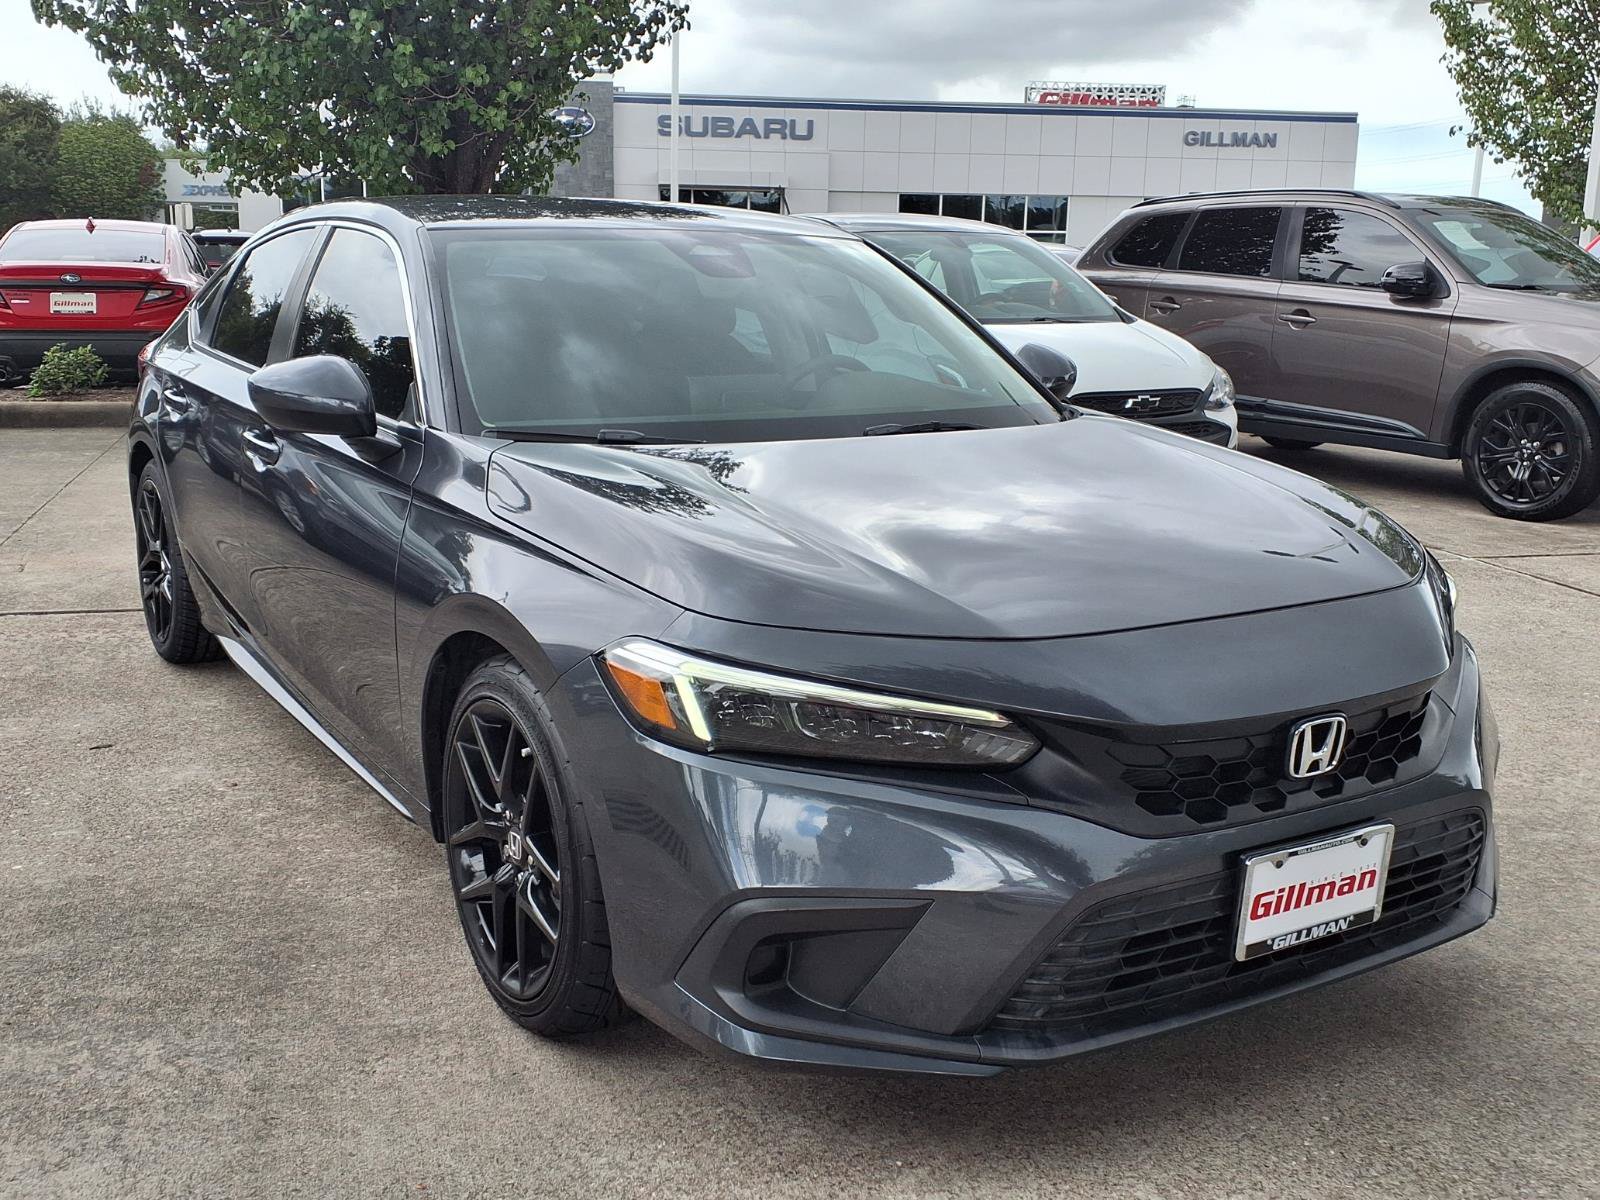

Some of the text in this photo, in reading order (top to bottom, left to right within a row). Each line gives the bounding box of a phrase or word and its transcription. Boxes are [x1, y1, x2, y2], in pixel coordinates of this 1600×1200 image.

[657, 114, 815, 141] SUBARU
[1183, 130, 1278, 148] GILLMAN
[1249, 868, 1377, 921] Gillman
[1272, 917, 1351, 951] GILLMAN
